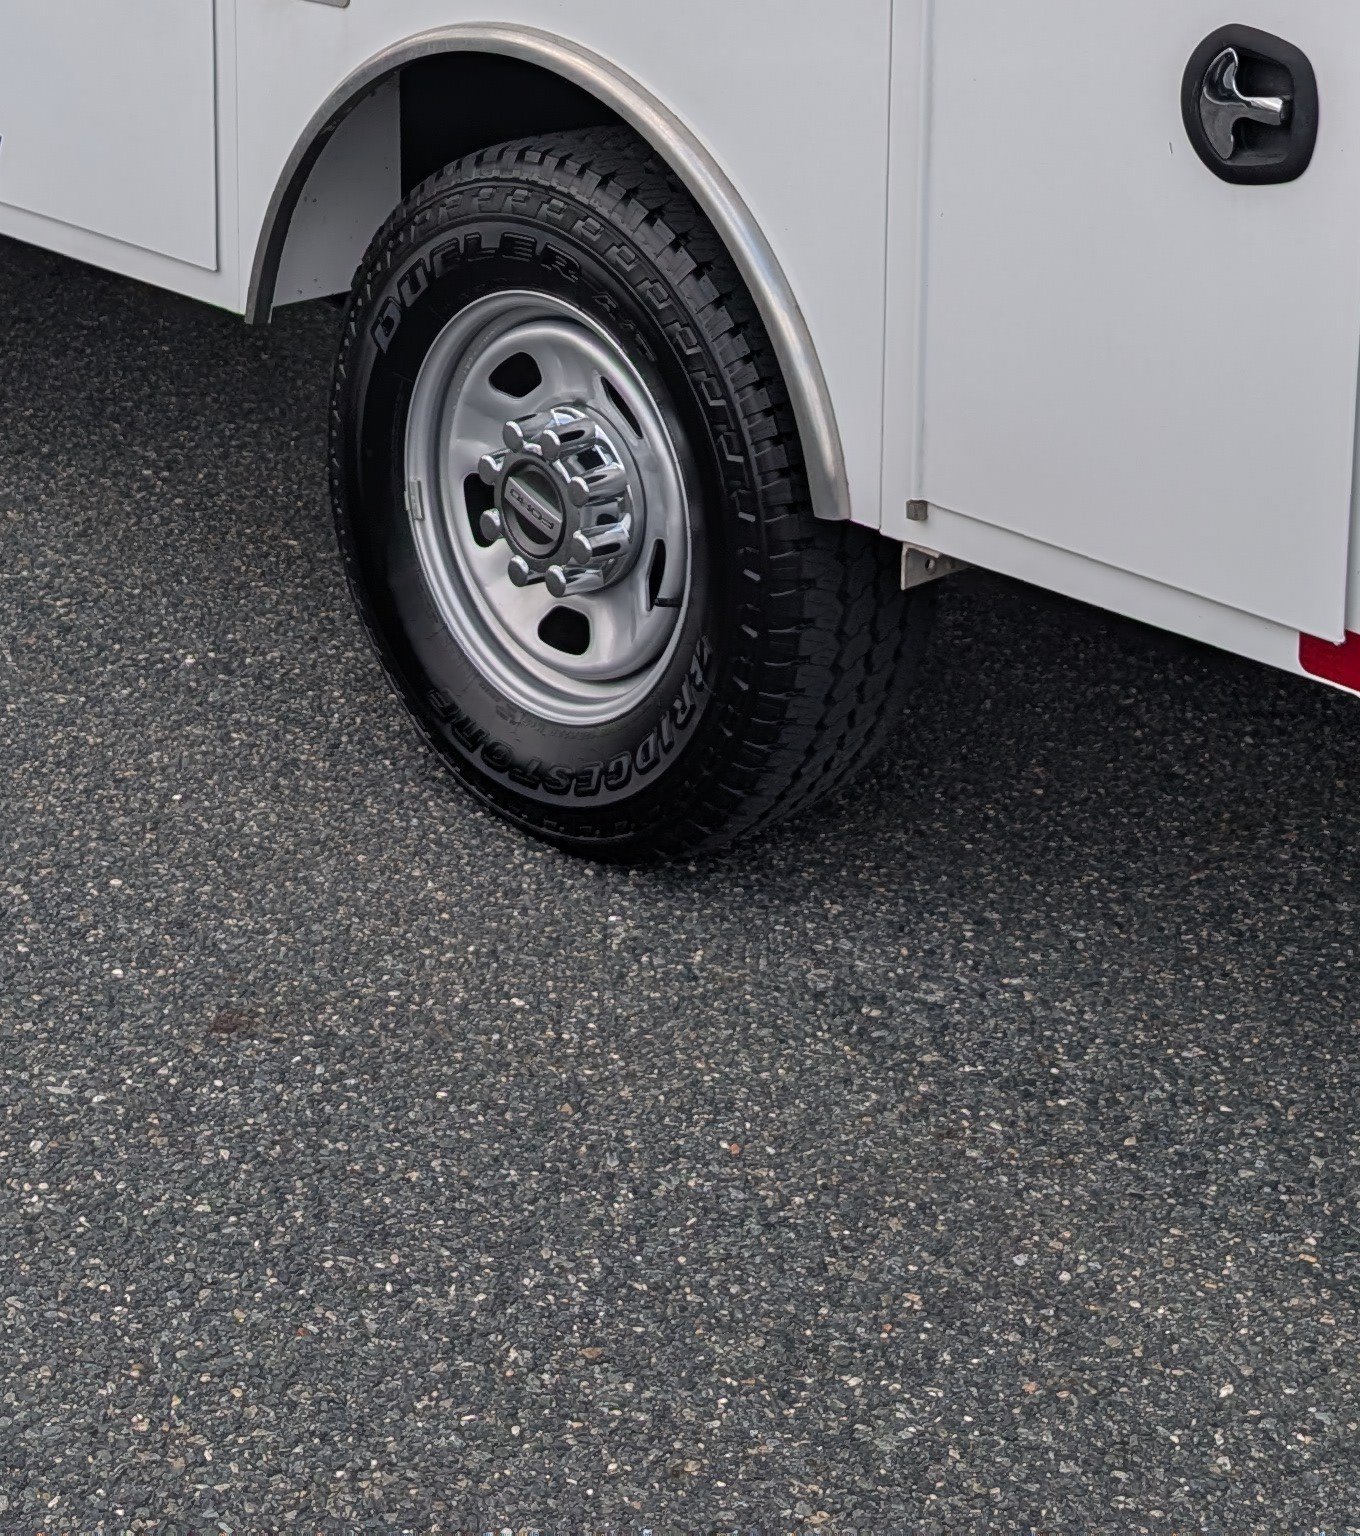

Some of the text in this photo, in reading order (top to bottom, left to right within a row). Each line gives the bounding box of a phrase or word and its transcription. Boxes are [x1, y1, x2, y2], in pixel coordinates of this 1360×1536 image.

[370, 231, 583, 355] DUELER
[509, 488, 555, 530] FORD
[428, 633, 714, 798] BRIDGESTONE
